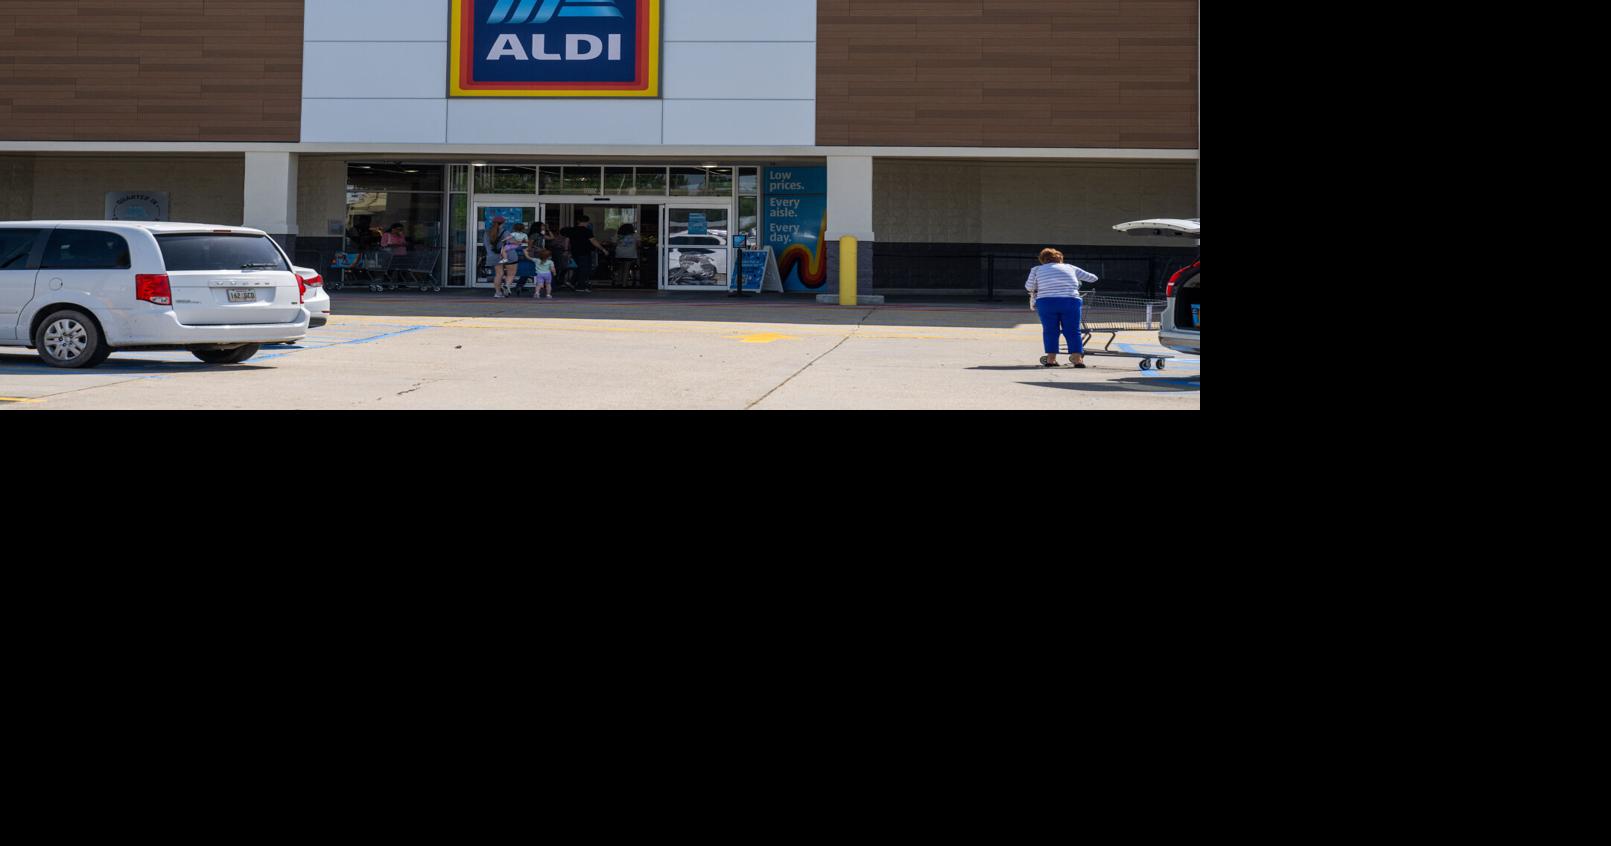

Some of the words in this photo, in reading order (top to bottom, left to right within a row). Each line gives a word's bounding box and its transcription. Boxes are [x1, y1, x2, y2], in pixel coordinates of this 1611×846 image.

[486, 33, 621, 60] ALDI
[769, 170, 792, 180] Low
[769, 179, 805, 193] prices.
[769, 197, 800, 209] Every
[769, 207, 798, 217] aisle.
[769, 223, 800, 233] Every
[769, 232, 792, 244] day.
